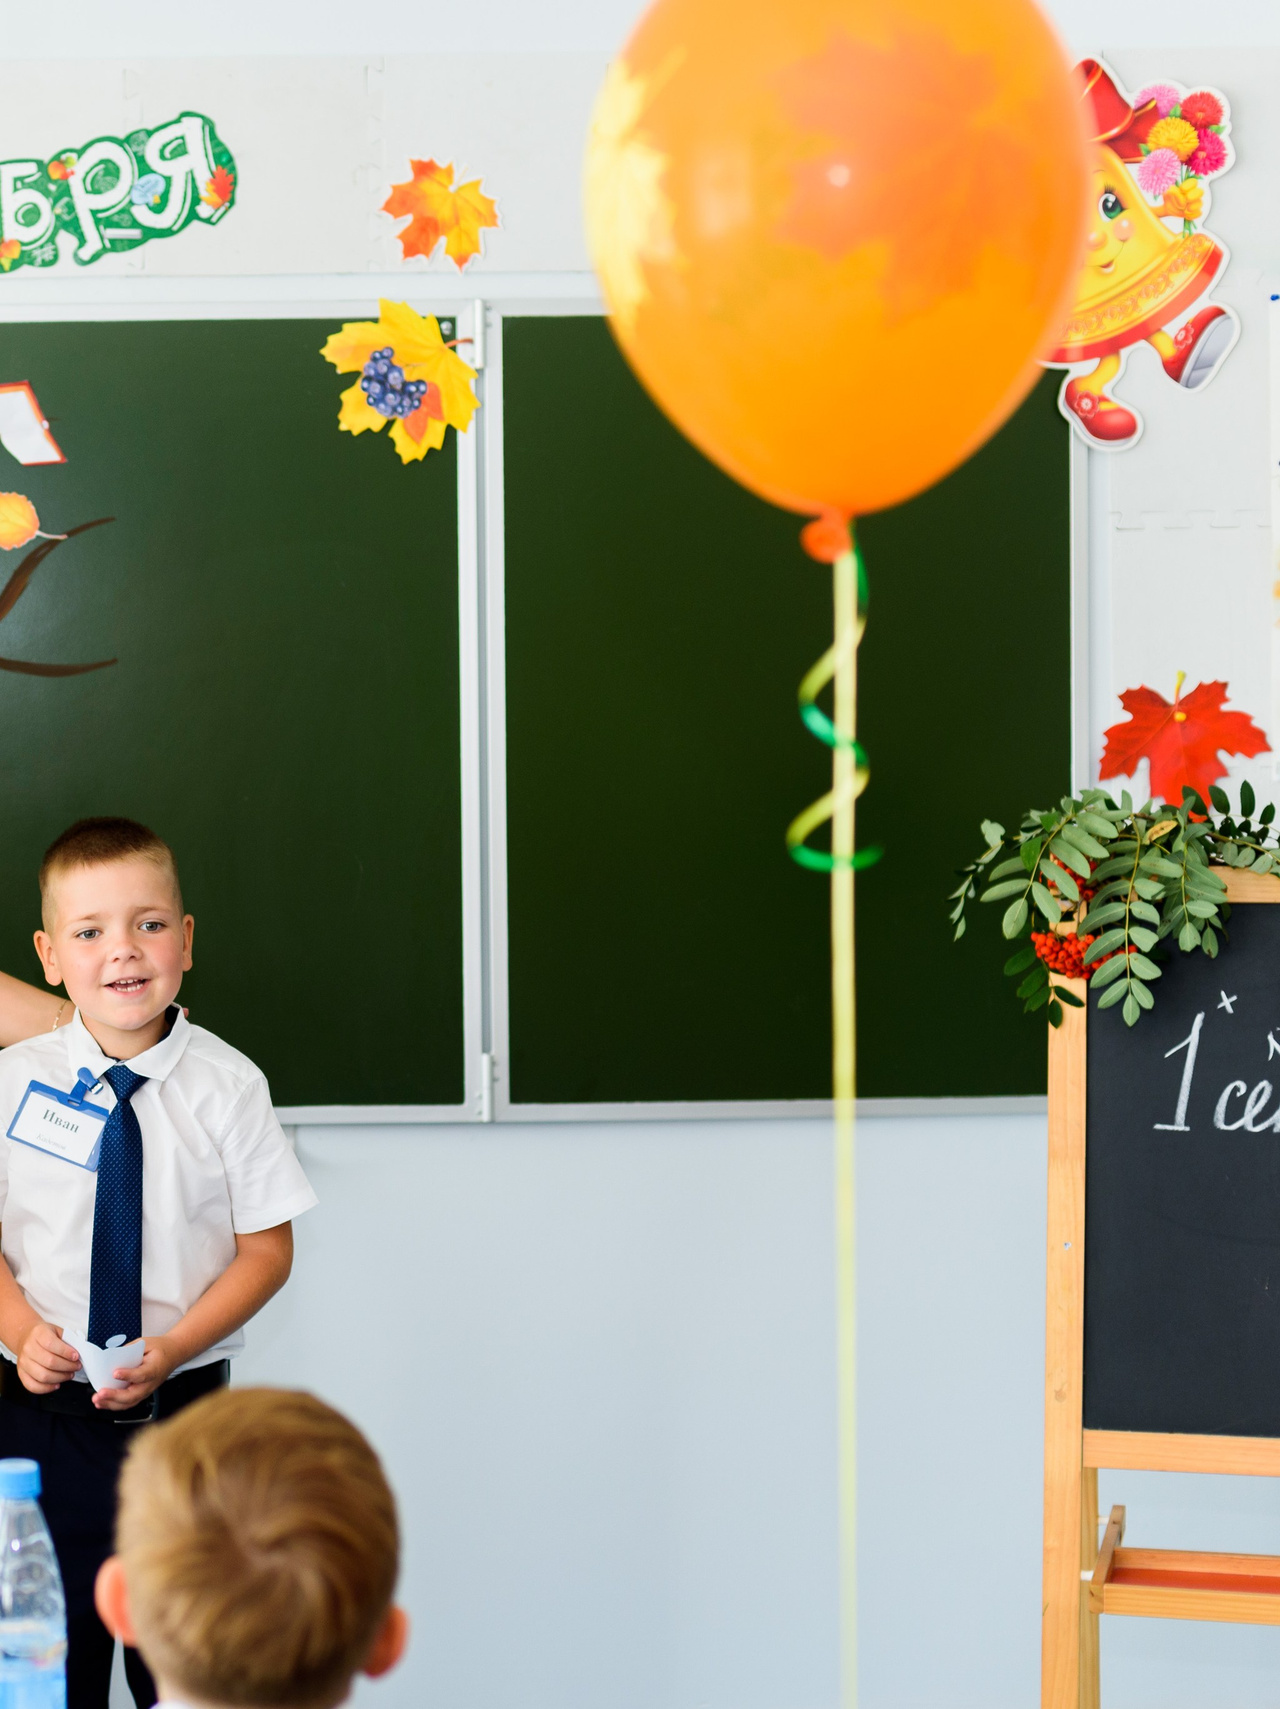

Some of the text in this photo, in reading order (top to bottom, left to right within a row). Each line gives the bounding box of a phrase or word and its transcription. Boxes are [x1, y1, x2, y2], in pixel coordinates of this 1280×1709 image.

[1153, 1011, 1280, 1133] 1 се
[42, 1109, 80, 1133] Иван
